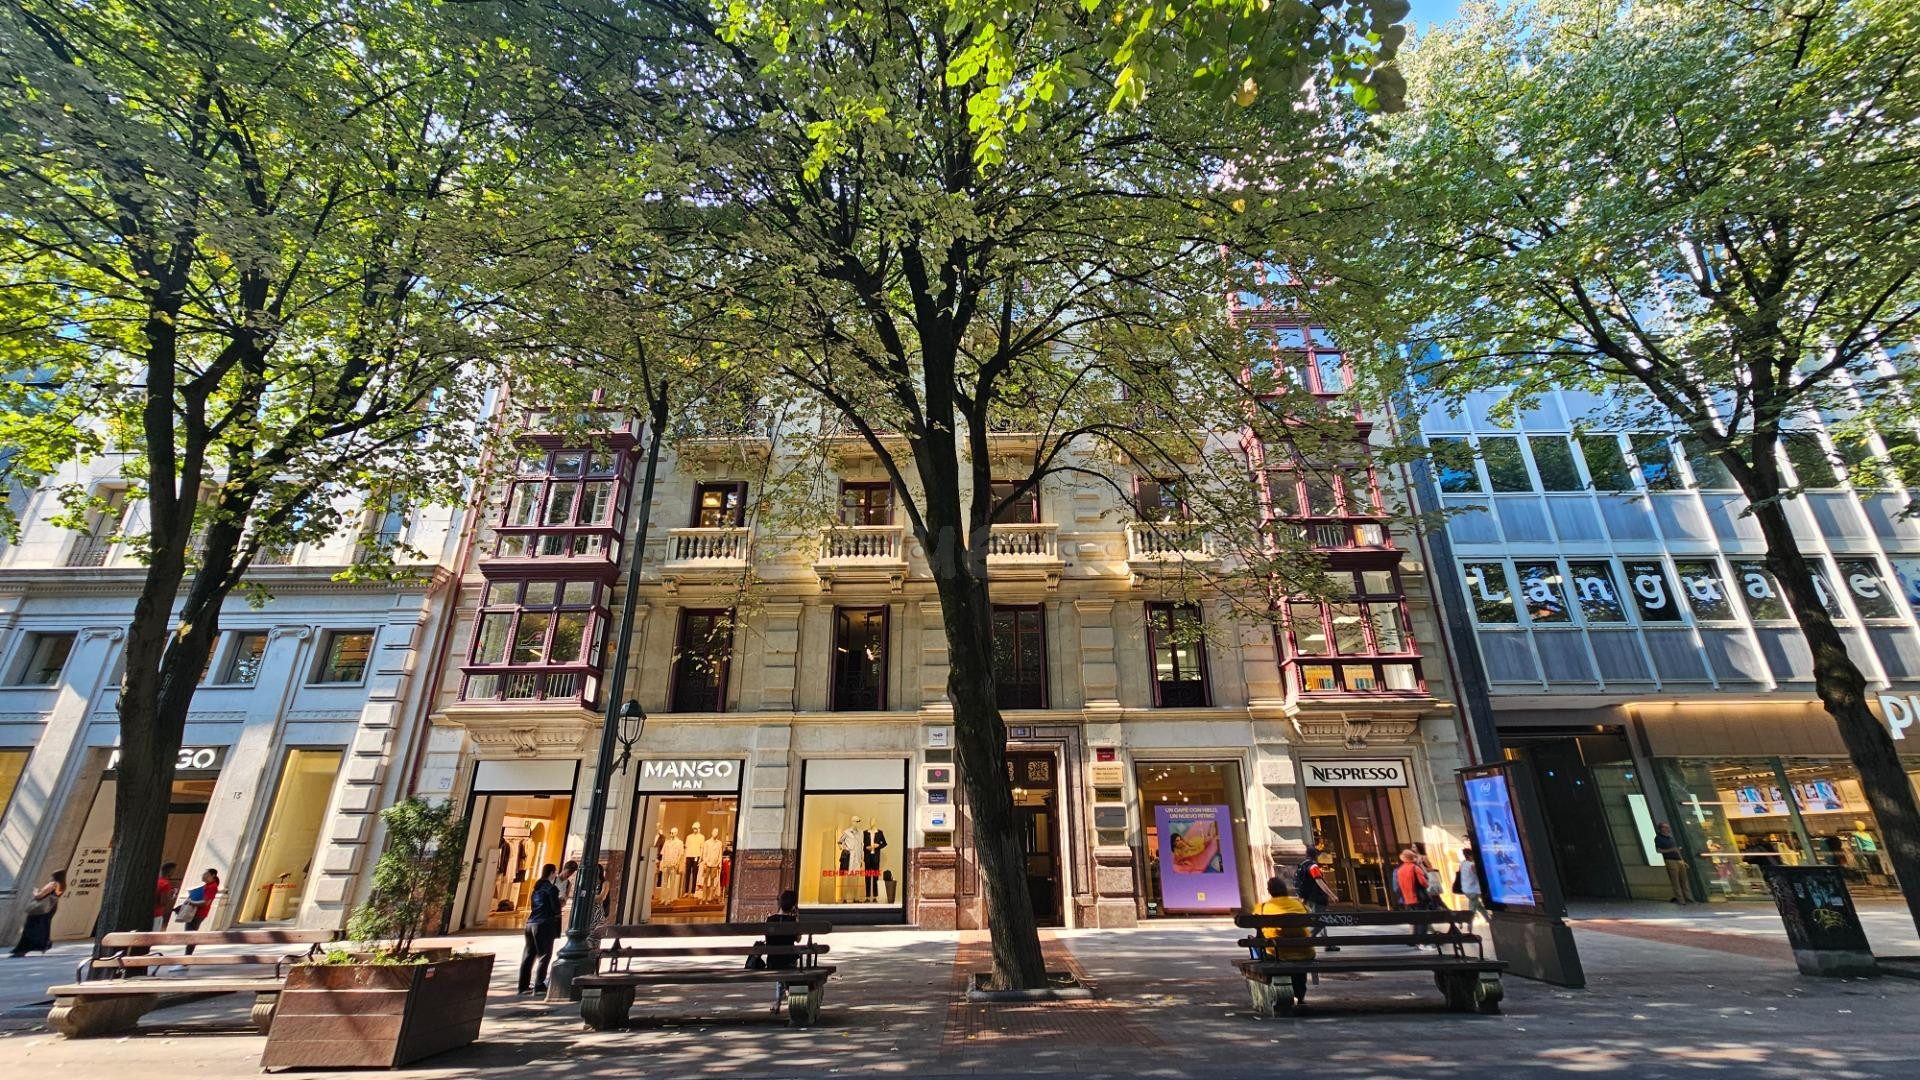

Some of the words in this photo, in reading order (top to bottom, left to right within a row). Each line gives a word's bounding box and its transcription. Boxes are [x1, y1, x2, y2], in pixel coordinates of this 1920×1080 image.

[644, 760, 733, 778] MANGO
[1307, 764, 1398, 783] NESPRESSO
[672, 780, 703, 789] MAN
[77, 858, 85, 867] 2
